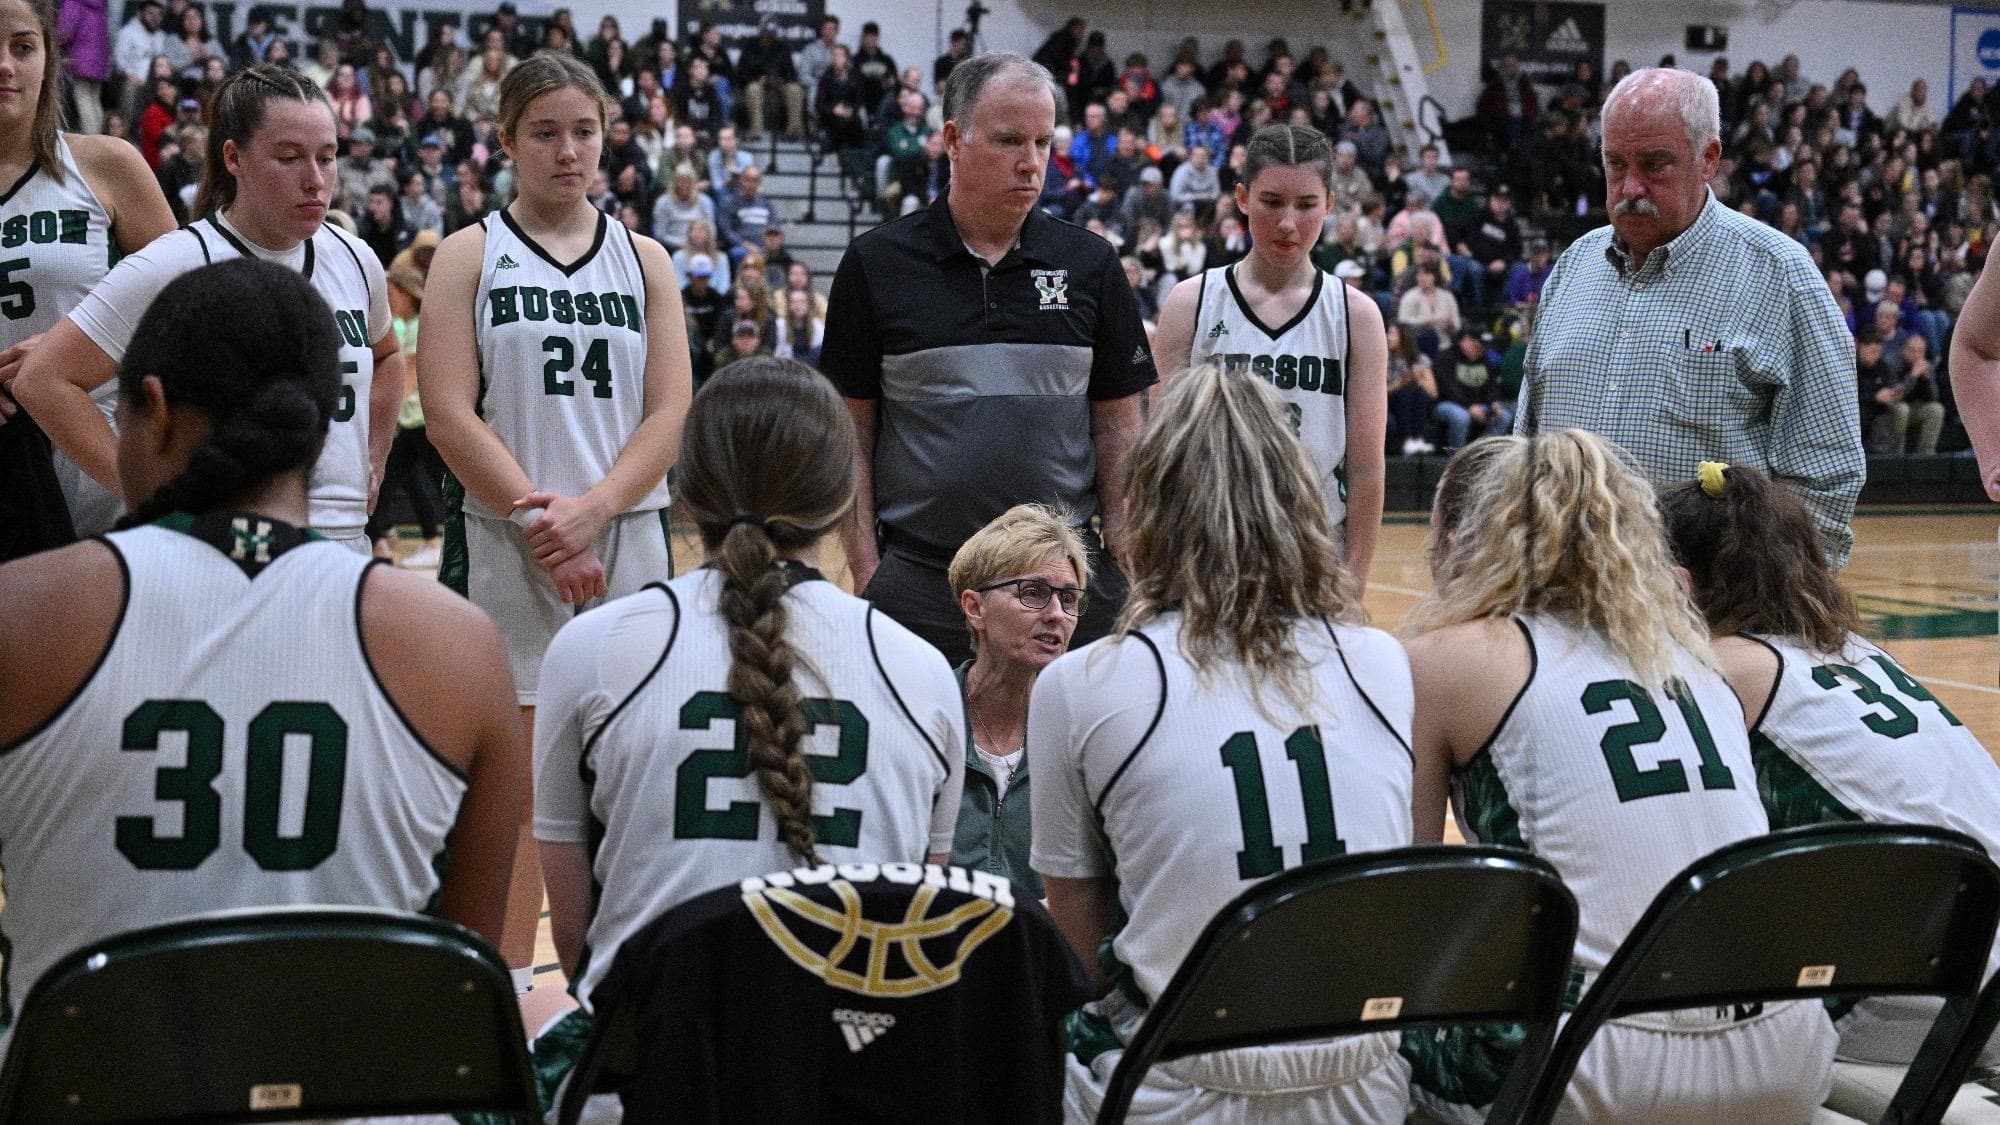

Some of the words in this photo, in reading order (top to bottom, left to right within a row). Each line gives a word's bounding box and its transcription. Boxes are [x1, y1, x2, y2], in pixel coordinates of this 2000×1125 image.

[0, 209, 90, 248] SON
[489, 285, 641, 333] HUSSON
[542, 335, 613, 399] 24
[1581, 674, 1736, 803] 21
[1811, 655, 1963, 739] 34
[115, 699, 348, 871] 30
[674, 690, 869, 848] 22
[1219, 724, 1346, 880] 11
